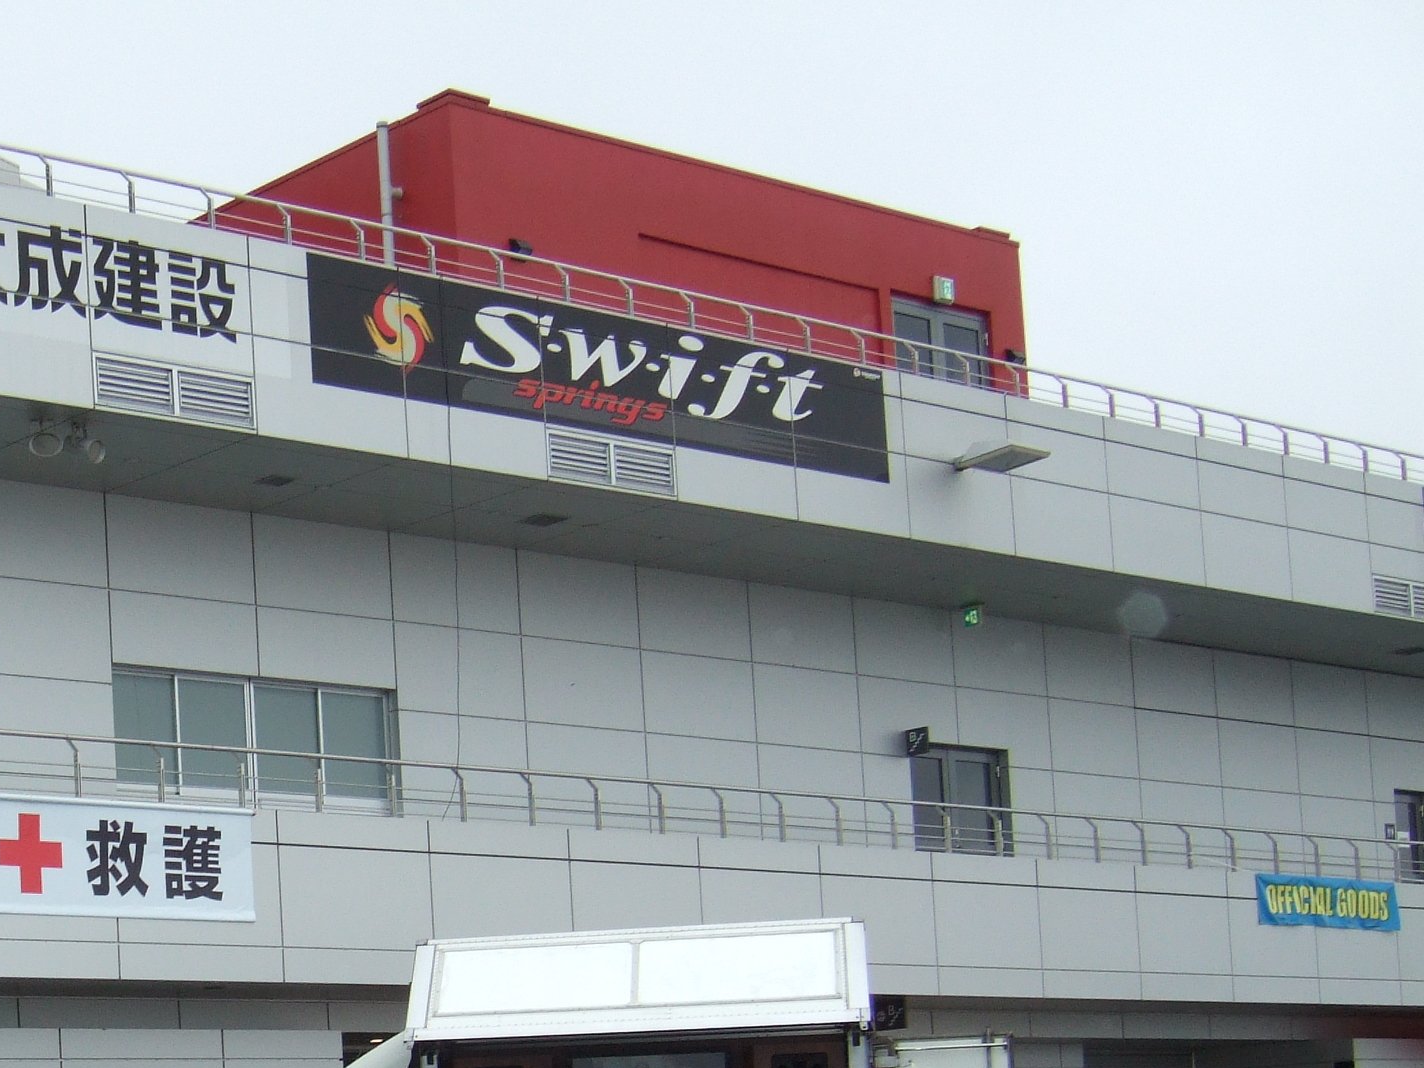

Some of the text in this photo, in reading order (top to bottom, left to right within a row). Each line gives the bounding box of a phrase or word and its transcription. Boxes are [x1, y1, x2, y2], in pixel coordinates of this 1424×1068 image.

[513, 379, 666, 425] springs
[86, 819, 223, 901] 救護
[1265, 884, 1389, 922] OFFICIAL GOODS
